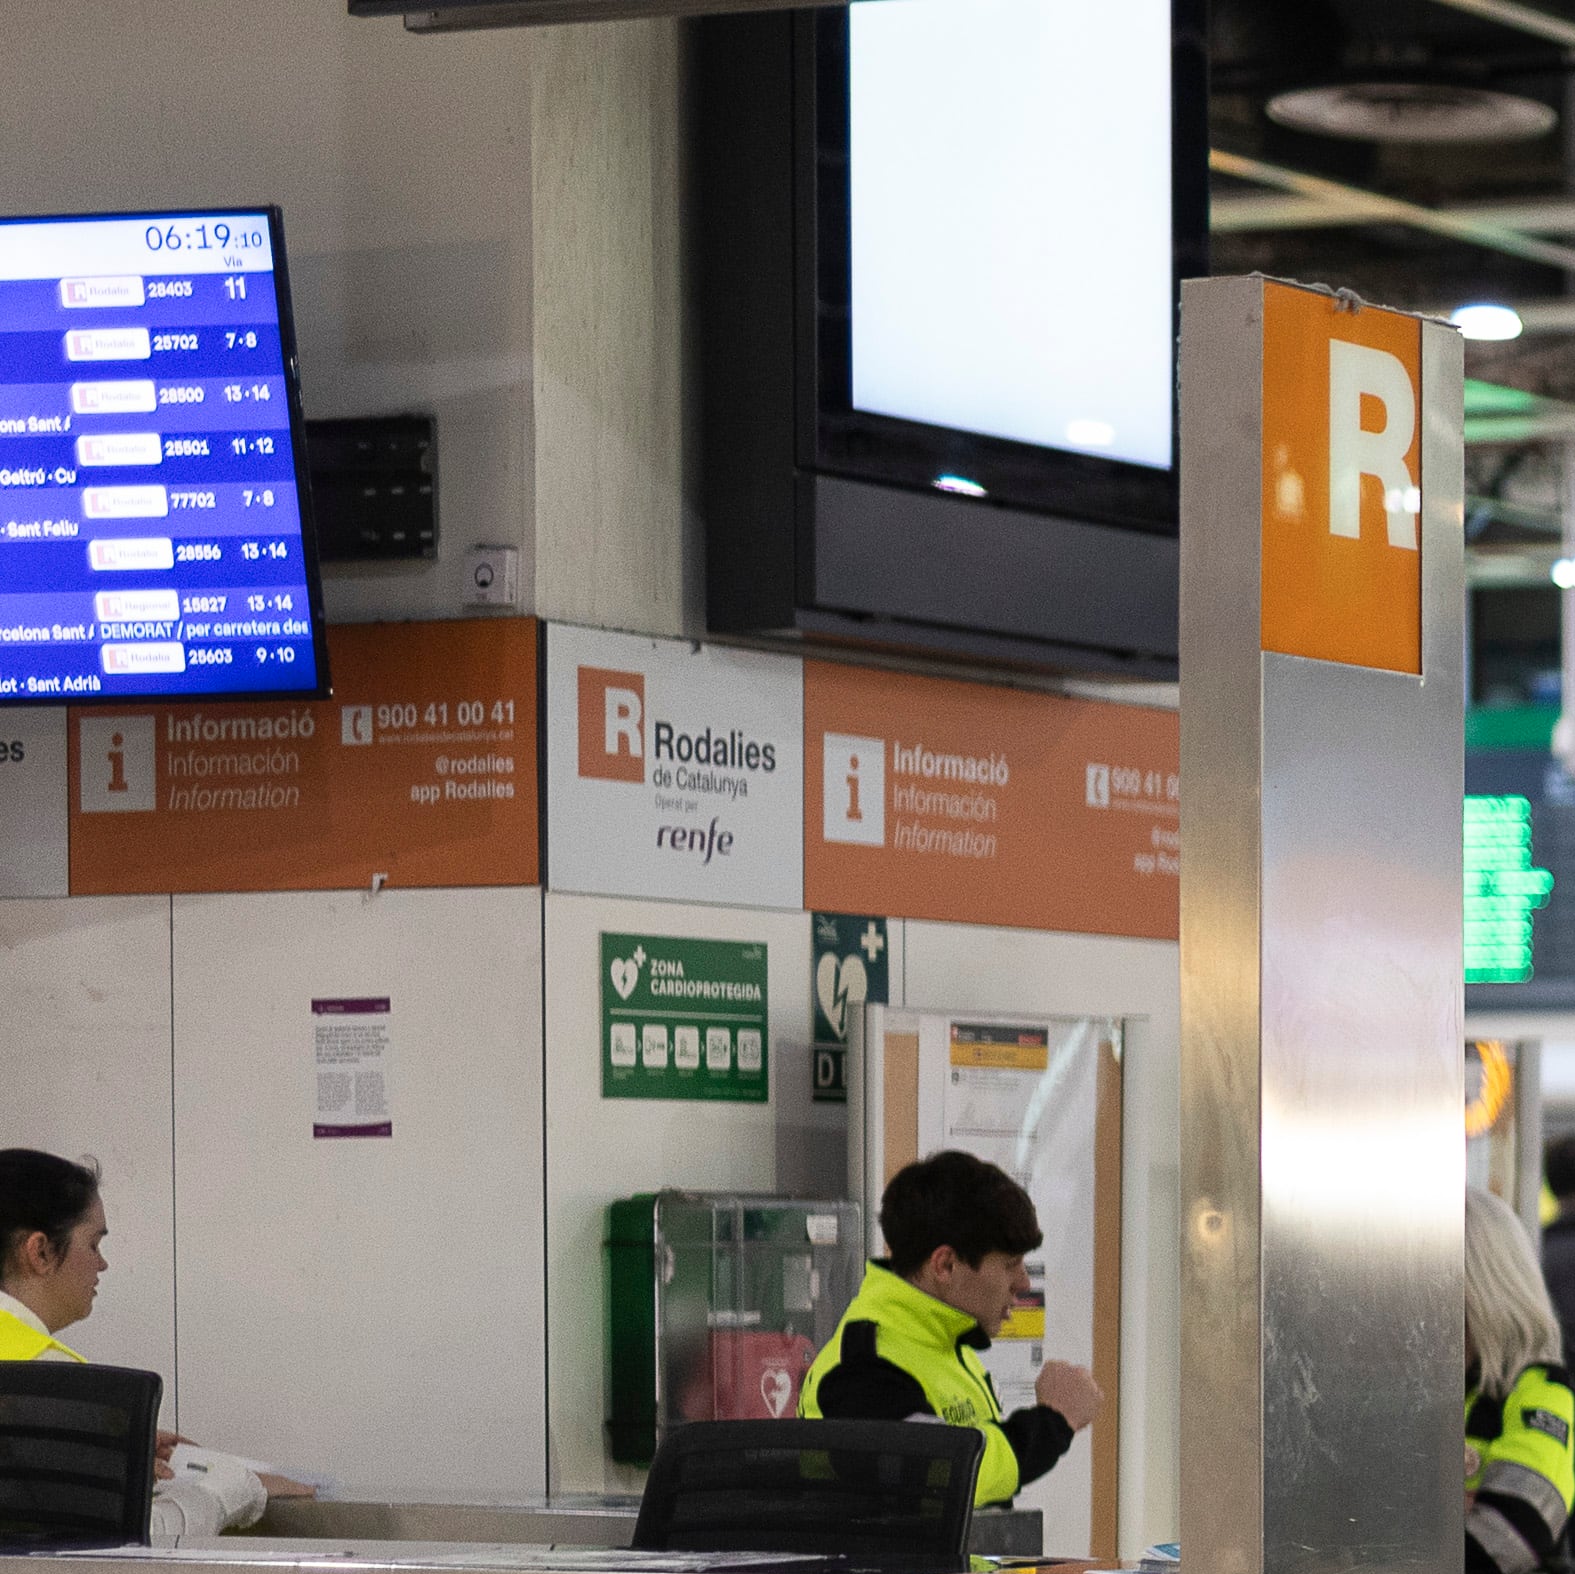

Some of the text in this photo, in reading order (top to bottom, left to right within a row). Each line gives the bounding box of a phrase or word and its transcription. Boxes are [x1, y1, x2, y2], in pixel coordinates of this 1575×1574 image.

[148, 281, 192, 298] 28403
[225, 276, 246, 300] 11
[154, 334, 198, 351] 25702
[165, 439, 210, 456] 25501
[1329, 338, 1418, 551] R
[170, 491, 216, 509] 77702
[101, 621, 174, 640] DEMORAT
[189, 648, 233, 665] 25603
[167, 708, 315, 743] Informació
[377, 699, 515, 729] 900 41 00 41
[604, 686, 643, 758] R
[654, 720, 777, 774] Rodalies
[168, 747, 300, 778] Información
[435, 754, 515, 776] @rodalies
[893, 740, 1009, 787] Informació
[168, 783, 300, 811] Information
[411, 779, 515, 805] app Rodalies
[653, 764, 748, 802] de Catalunya
[1166, 771, 1180, 802] 0
[893, 782, 997, 823] Información
[656, 815, 734, 867] renfe
[893, 820, 998, 859] Information
[650, 958, 684, 978] ZONA
[650, 979, 762, 1001] CARDIOPROTEGIDA
